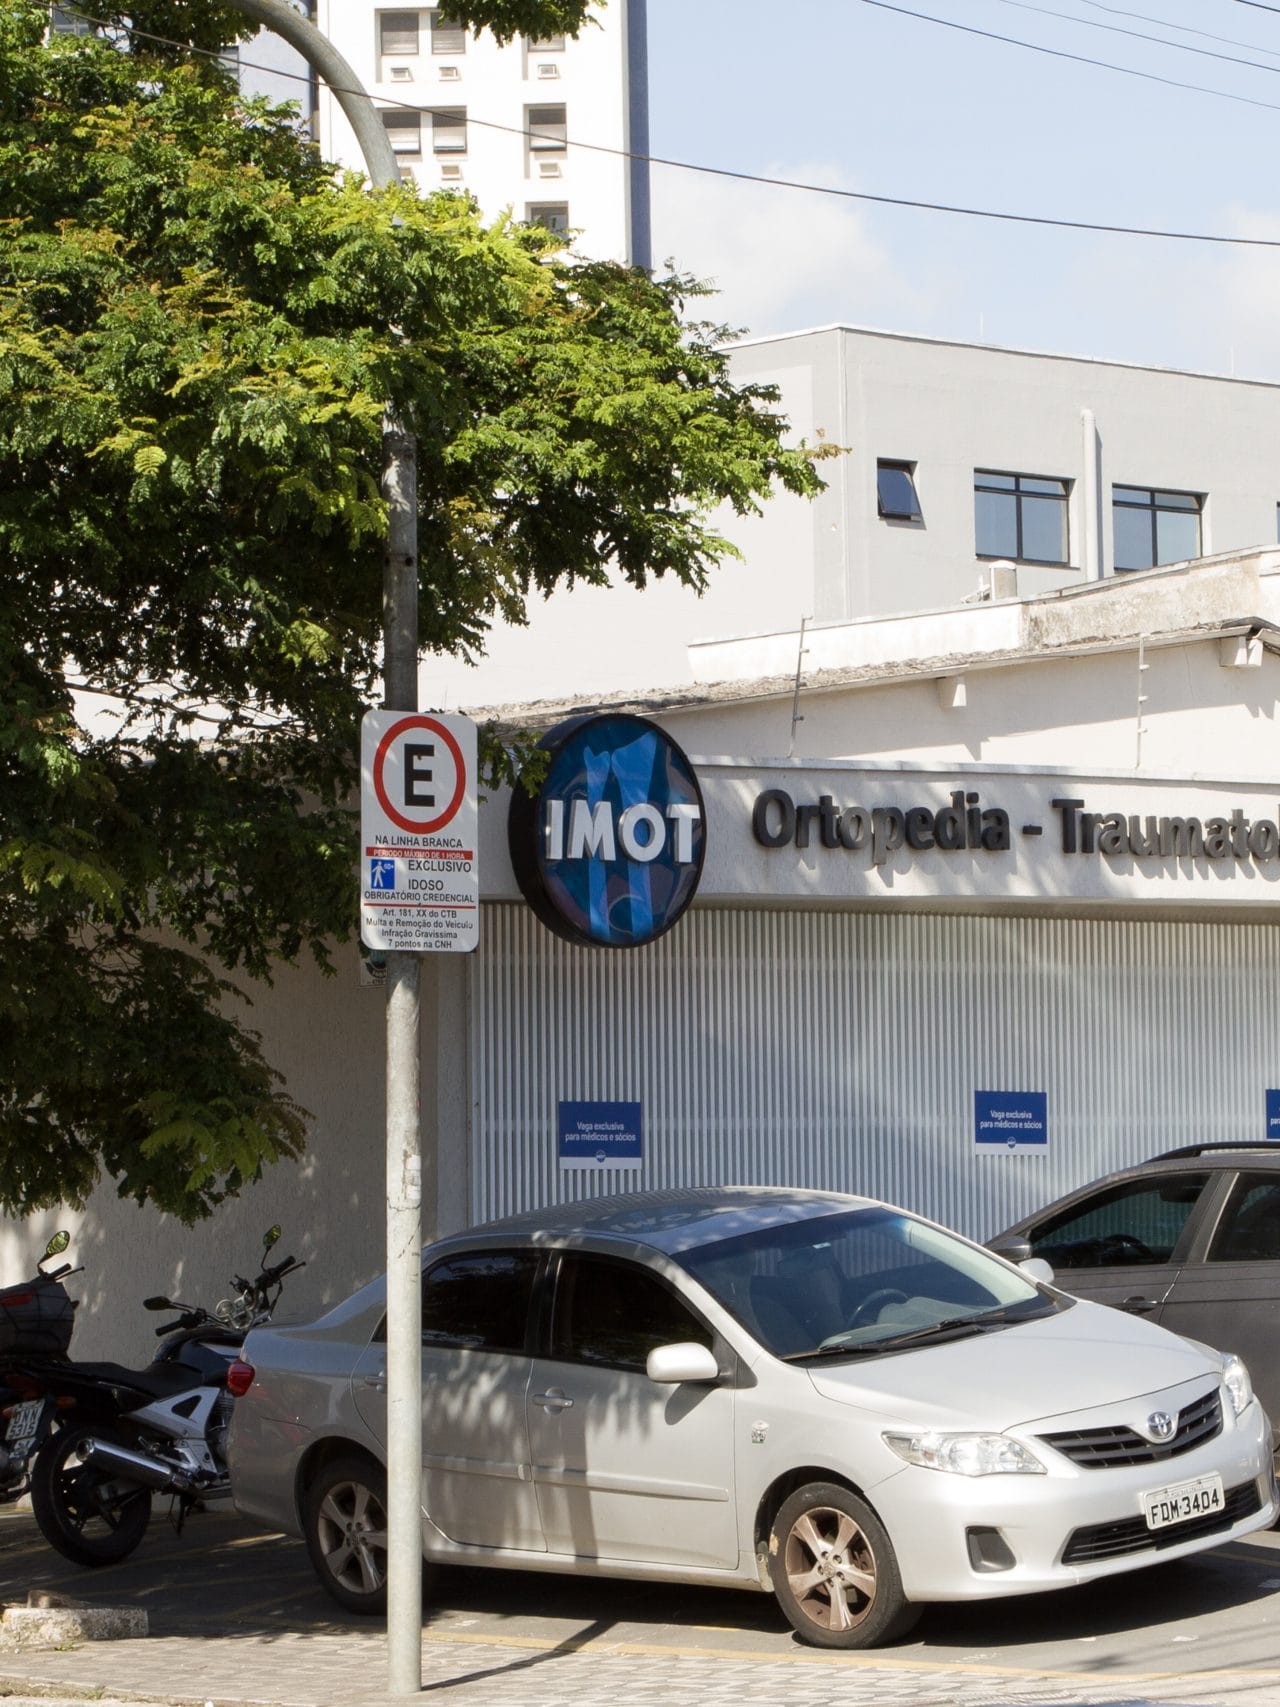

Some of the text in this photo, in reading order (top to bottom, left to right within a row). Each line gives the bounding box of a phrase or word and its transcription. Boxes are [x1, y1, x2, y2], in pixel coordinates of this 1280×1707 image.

[404, 743, 435, 807] E
[545, 799, 700, 863] IMOT
[752, 789, 1010, 865] Ortopedia
[1022, 824, 1043, 836] -
[375, 835, 463, 848] NA LINHA BRANCA
[431, 851, 441, 859] DE
[446, 852, 465, 860] HORA
[408, 860, 472, 872] EXCLUSIVO
[408, 879, 444, 890] IDOSO
[364, 891, 475, 903] OBRIGATÓRIO CREDENCIAL
[383, 908, 397, 917] Art.
[416, 909, 427, 917] XX
[429, 910, 439, 918] do
[441, 910, 457, 919] CTB
[395, 919, 432, 928] Remoção
[434, 920, 443, 928] do
[382, 929, 413, 938] Infração
[394, 940, 421, 948] pontos
[434, 940, 452, 948] CNH
[990, 1110, 1032, 1120] Vaga exclusiva
[577, 1121, 625, 1132] Vaga exclusiva
[980, 1121, 993, 1130] para
[994, 1120, 1019, 1129] médicos
[565, 1133, 580, 1143] para
[581, 1131, 608, 1141] médicos
[615, 1132, 636, 1141] sócios
